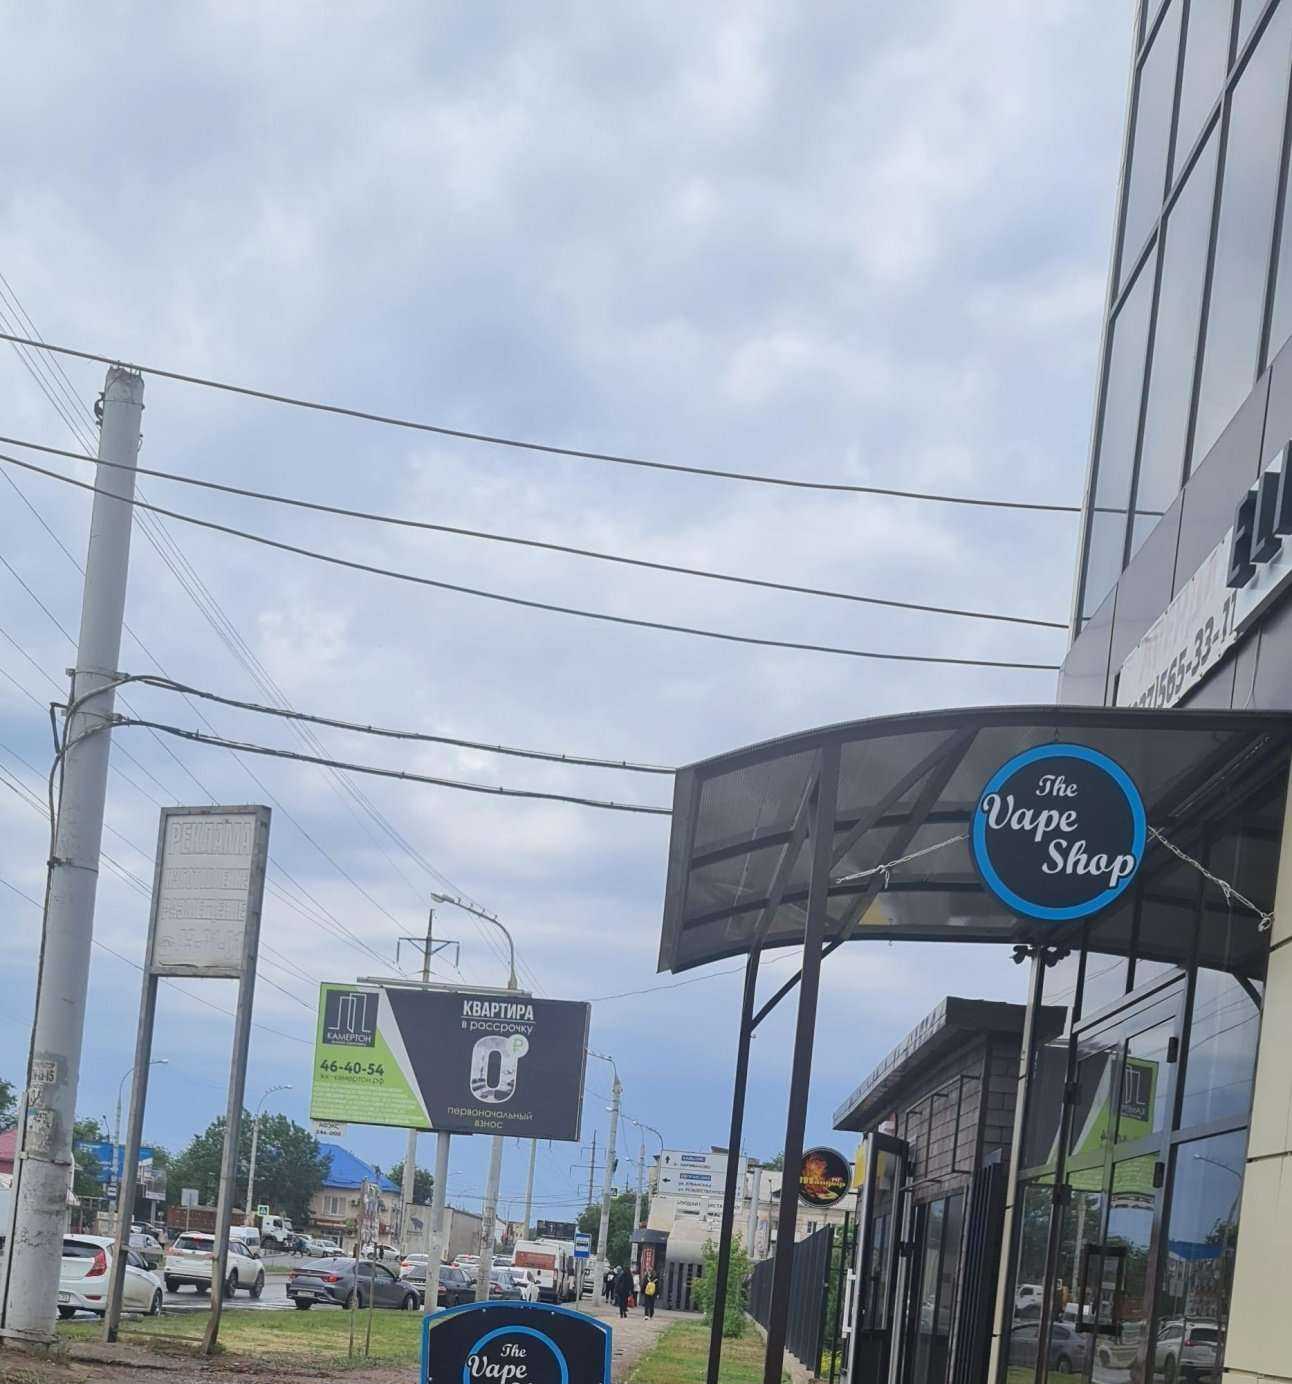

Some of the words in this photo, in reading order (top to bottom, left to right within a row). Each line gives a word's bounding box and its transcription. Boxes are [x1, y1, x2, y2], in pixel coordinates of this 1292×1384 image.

[1035, 774, 1078, 798] The
[982, 793, 1078, 842] Vape
[1041, 838, 1135, 888] Shop
[463, 1000, 535, 1021] КВАРТИРА
[470, 1020, 534, 1036] рассрочку
[327, 1031, 371, 1044] КАМЕРТОН
[320, 1060, 385, 1078] 46-40-54
[447, 1106, 533, 1121] первоначальный
[474, 1119, 503, 1130] взнос
[500, 1343, 527, 1358] The
[468, 1355, 528, 1384] Vape
